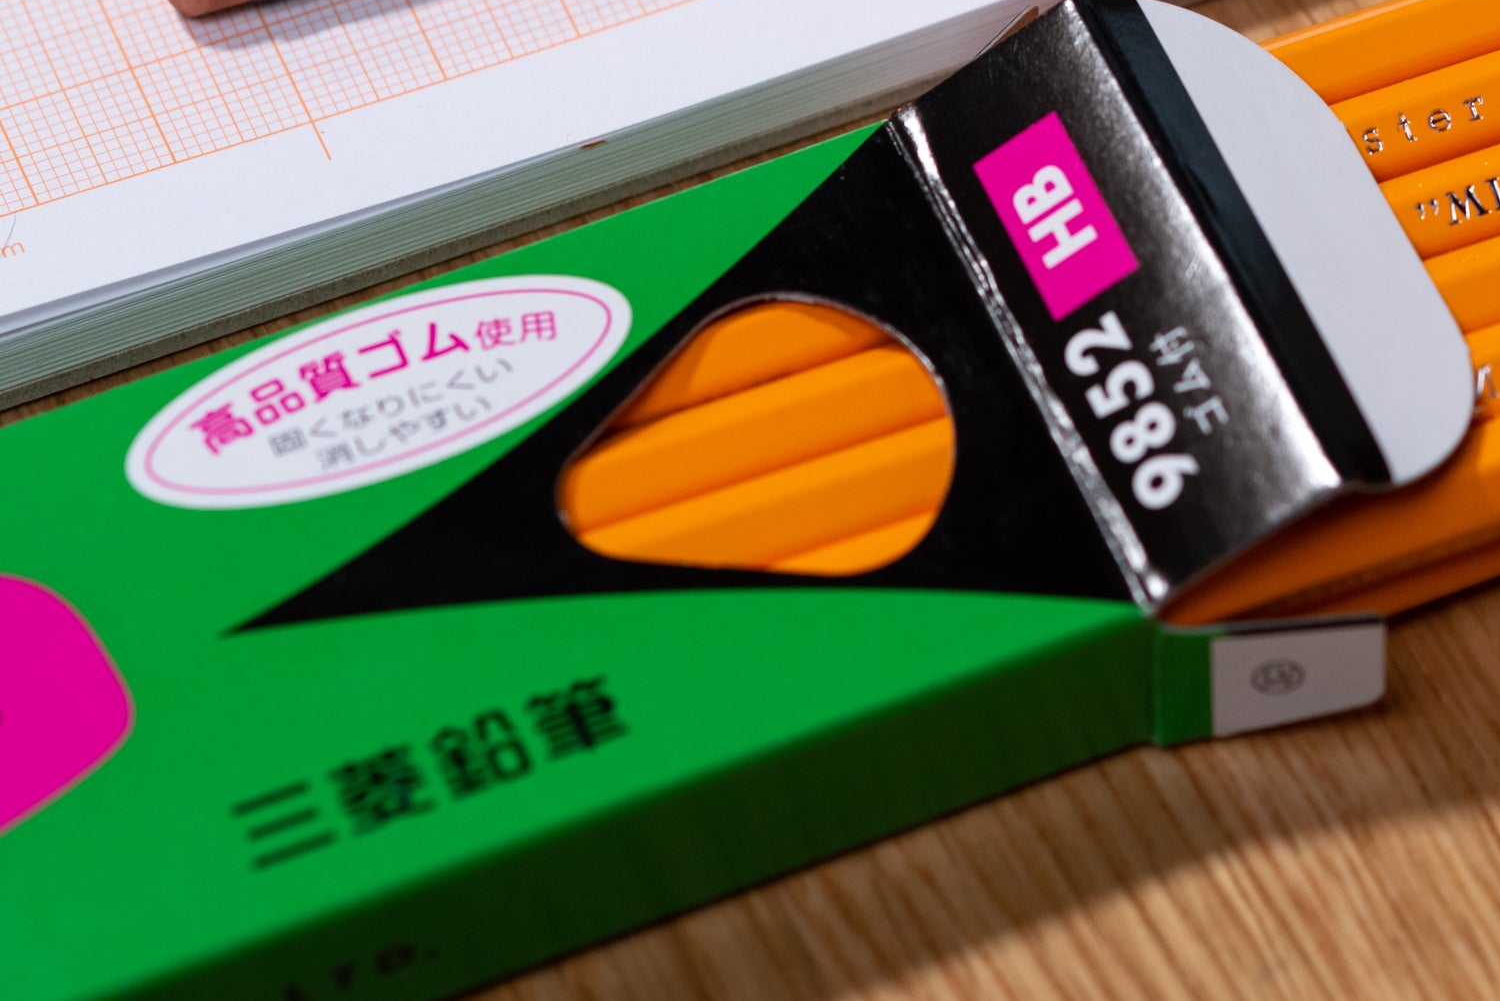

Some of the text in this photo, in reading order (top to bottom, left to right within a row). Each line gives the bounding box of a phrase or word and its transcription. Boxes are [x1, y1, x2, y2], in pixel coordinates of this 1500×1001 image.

[1362, 95, 1485, 156] ster
[1011, 162, 1099, 270] HB
[187, 310, 559, 457] 高品質ゴム使用
[266, 356, 515, 459] 固くなりにくい
[315, 396, 494, 472] 消しやすい
[1063, 309, 1201, 511] 9852
[1148, 324, 1230, 436] ゴム付
[228, 673, 632, 874] 三菱鉛筆
